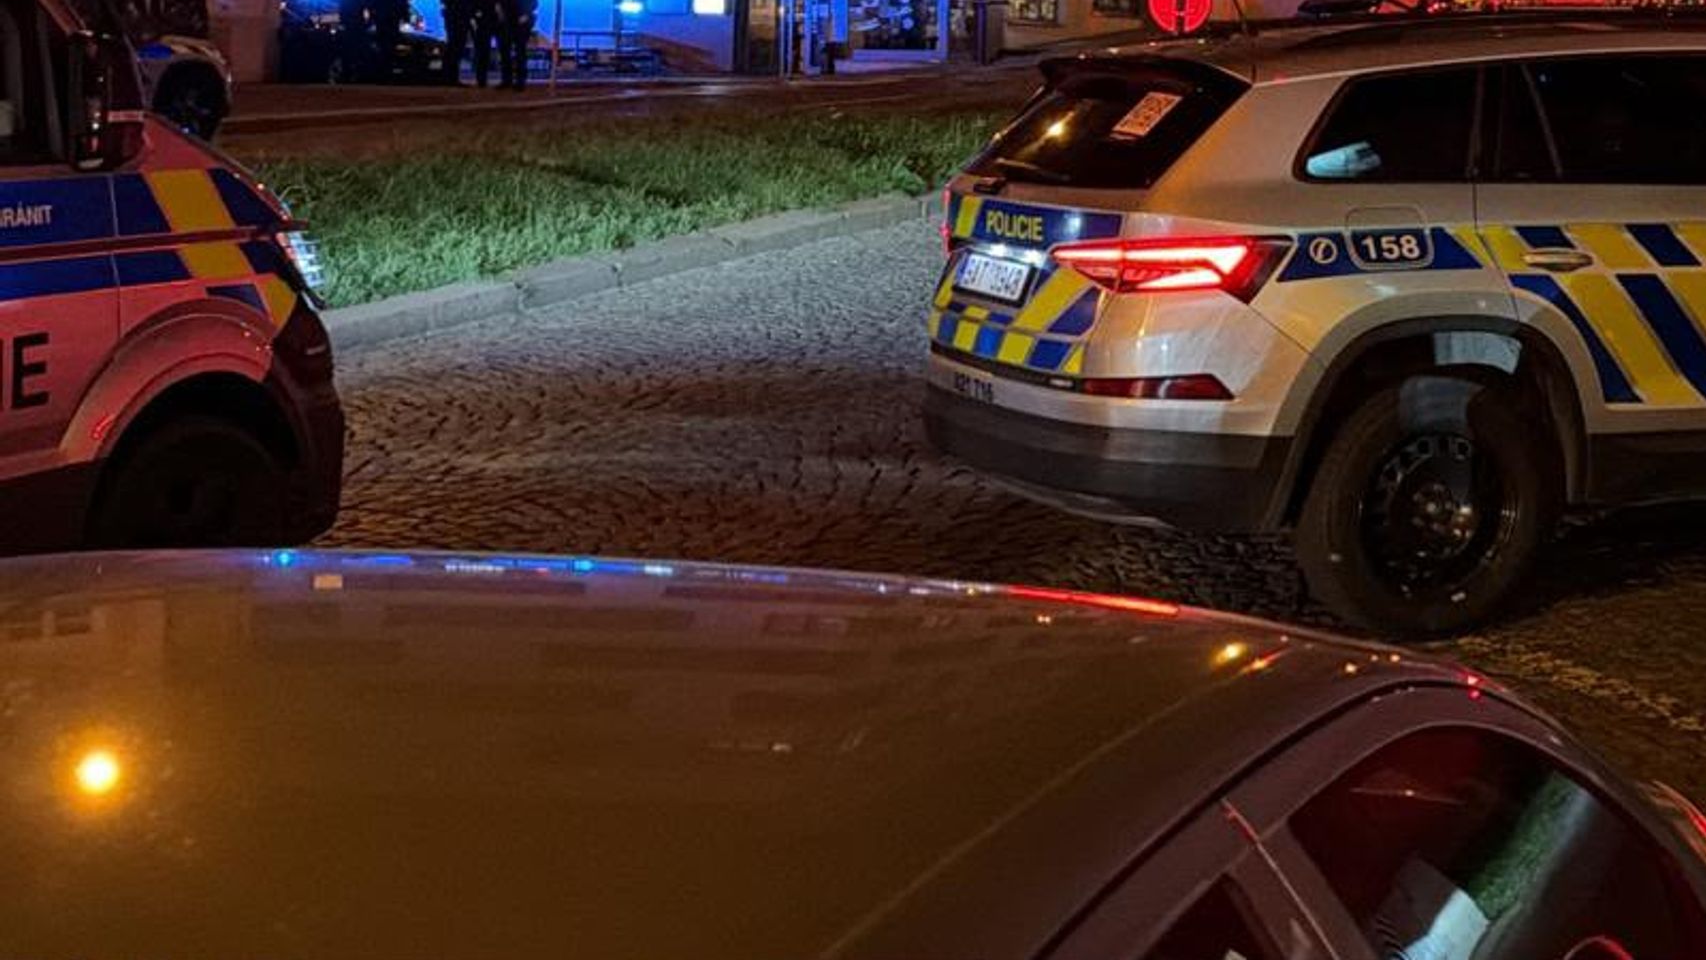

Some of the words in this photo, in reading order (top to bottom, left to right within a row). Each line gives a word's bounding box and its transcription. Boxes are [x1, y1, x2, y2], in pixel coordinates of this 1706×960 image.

[0, 201, 53, 228] RÁNIT
[985, 209, 1043, 241] POLICIE
[1361, 234, 1420, 261] 158
